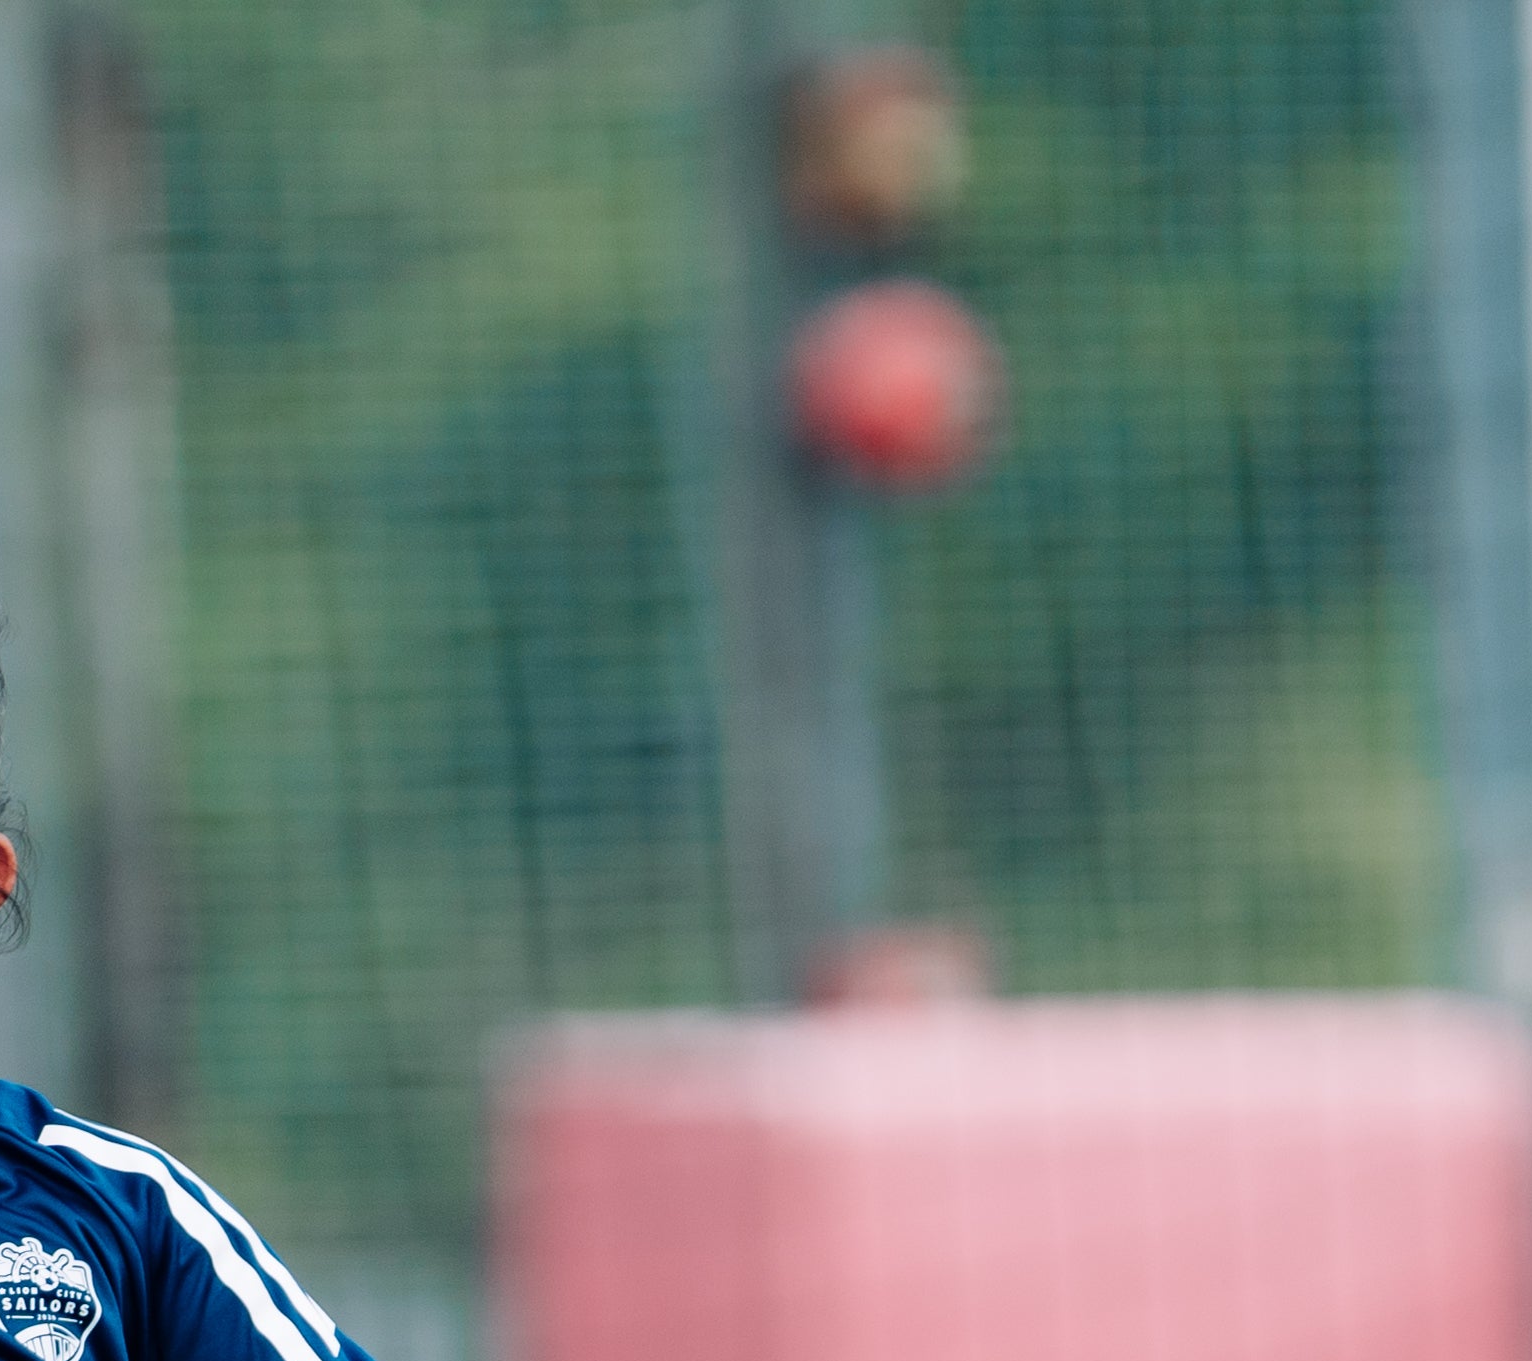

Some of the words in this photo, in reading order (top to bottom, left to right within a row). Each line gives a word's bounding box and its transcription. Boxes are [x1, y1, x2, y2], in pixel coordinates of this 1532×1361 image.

[8, 1286, 38, 1295] LION
[56, 1288, 83, 1300] CITY
[1, 1297, 90, 1317] SAILORS
